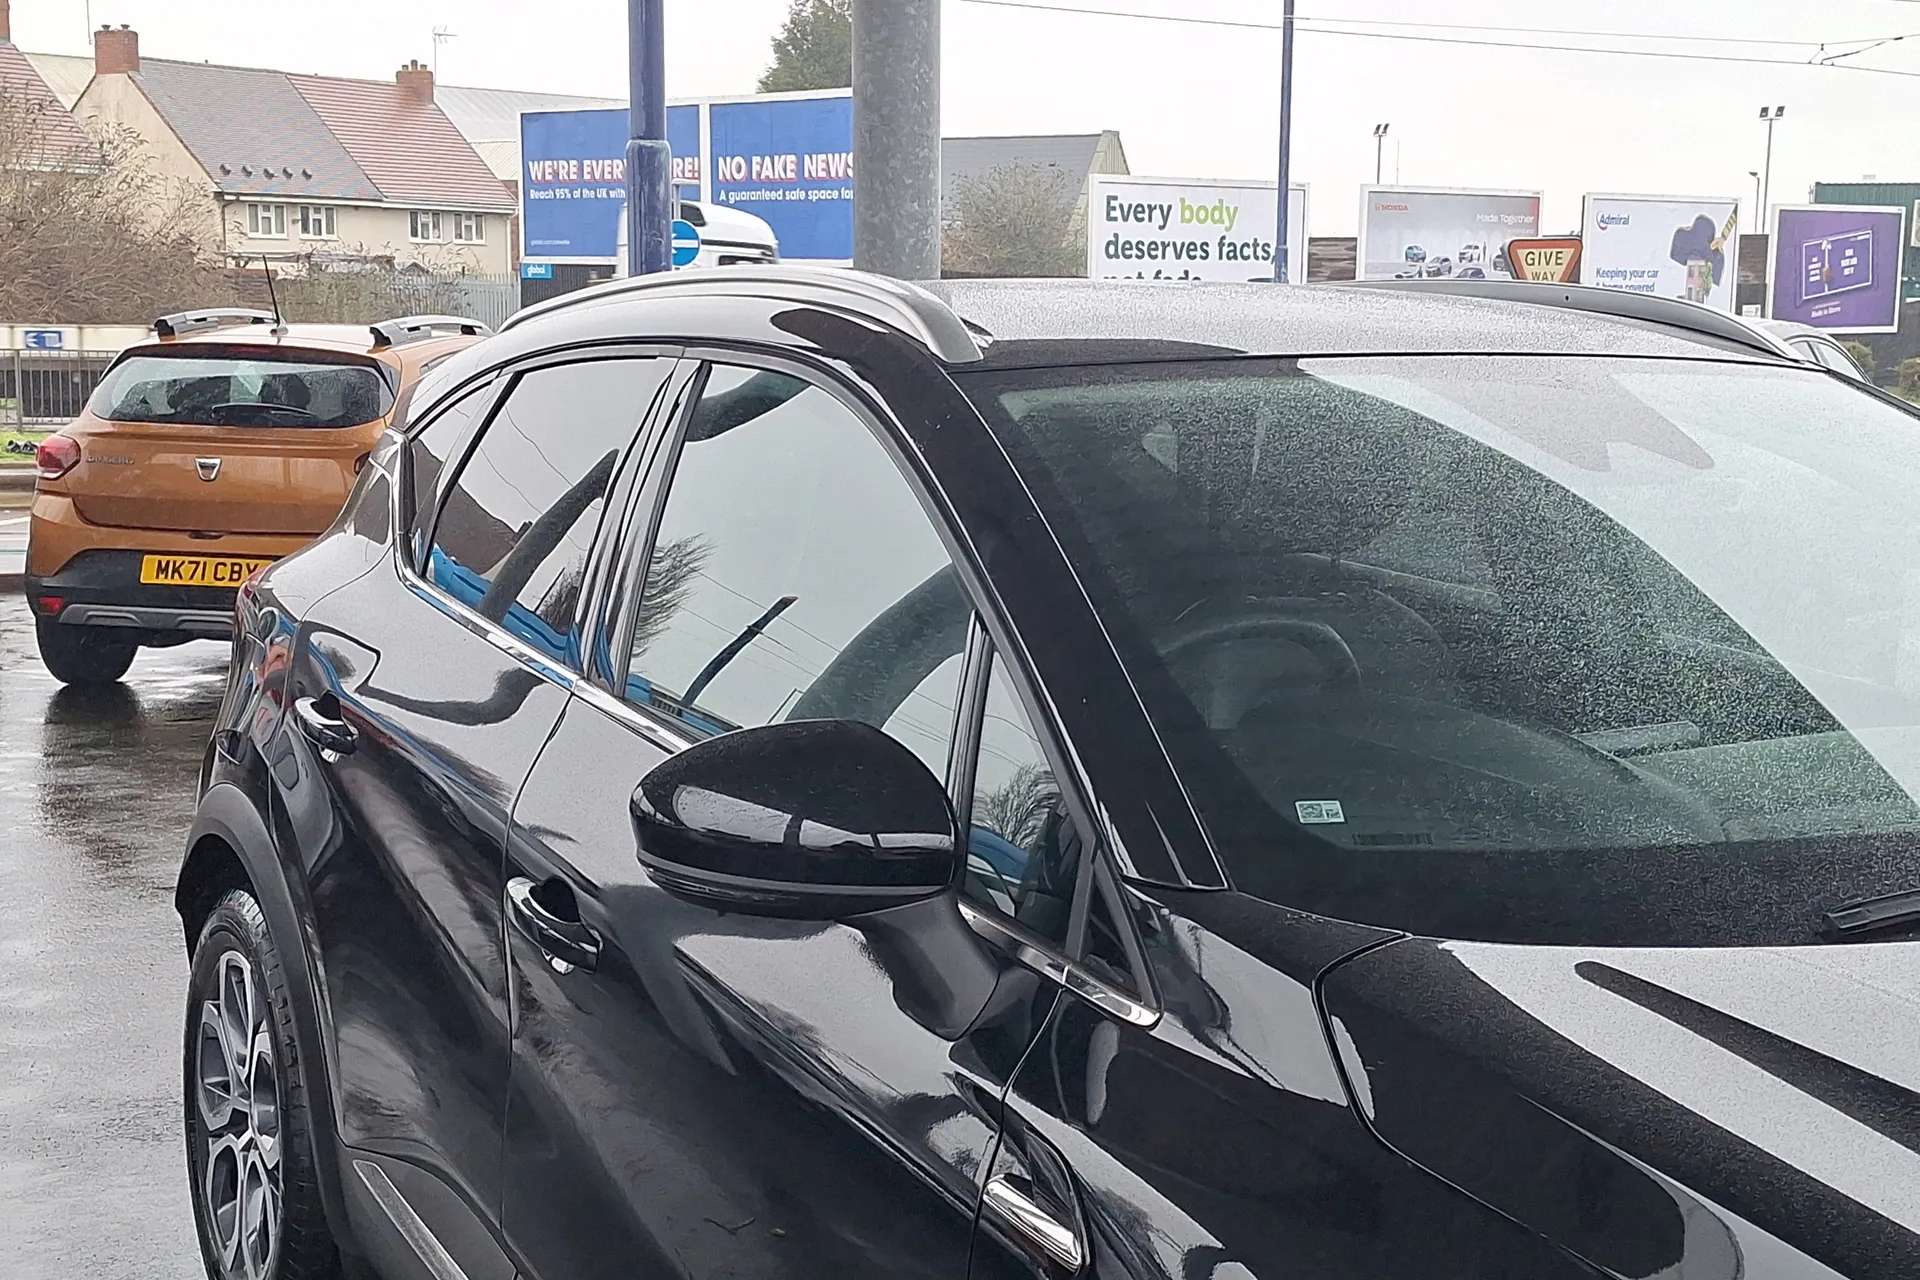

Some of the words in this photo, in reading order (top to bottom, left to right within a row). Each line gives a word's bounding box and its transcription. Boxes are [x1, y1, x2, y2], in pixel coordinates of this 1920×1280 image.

[528, 159, 578, 182] WE'RE
[717, 156, 747, 181] NO
[751, 154, 798, 181] FAKE
[529, 188, 554, 200] Reach
[555, 188, 571, 199] 95%
[572, 188, 581, 199] of
[582, 188, 595, 199] the
[596, 187, 608, 199] UK
[719, 190, 727, 201] A
[728, 189, 783, 204] guaranteed
[785, 189, 806, 201] safe
[808, 189, 839, 203] space
[1105, 195, 1172, 230] Every
[1179, 197, 1239, 232] body
[1600, 214, 1630, 226] Admiral
[1104, 233, 1210, 260] deserves
[1525, 250, 1563, 266] GIVE
[1531, 271, 1556, 281] WAY
[1596, 267, 1628, 281] Keeping
[1629, 270, 1646, 280] your
[1647, 270, 1659, 279] car
[155, 559, 207, 581] MK71
[213, 561, 259, 582] CBY
